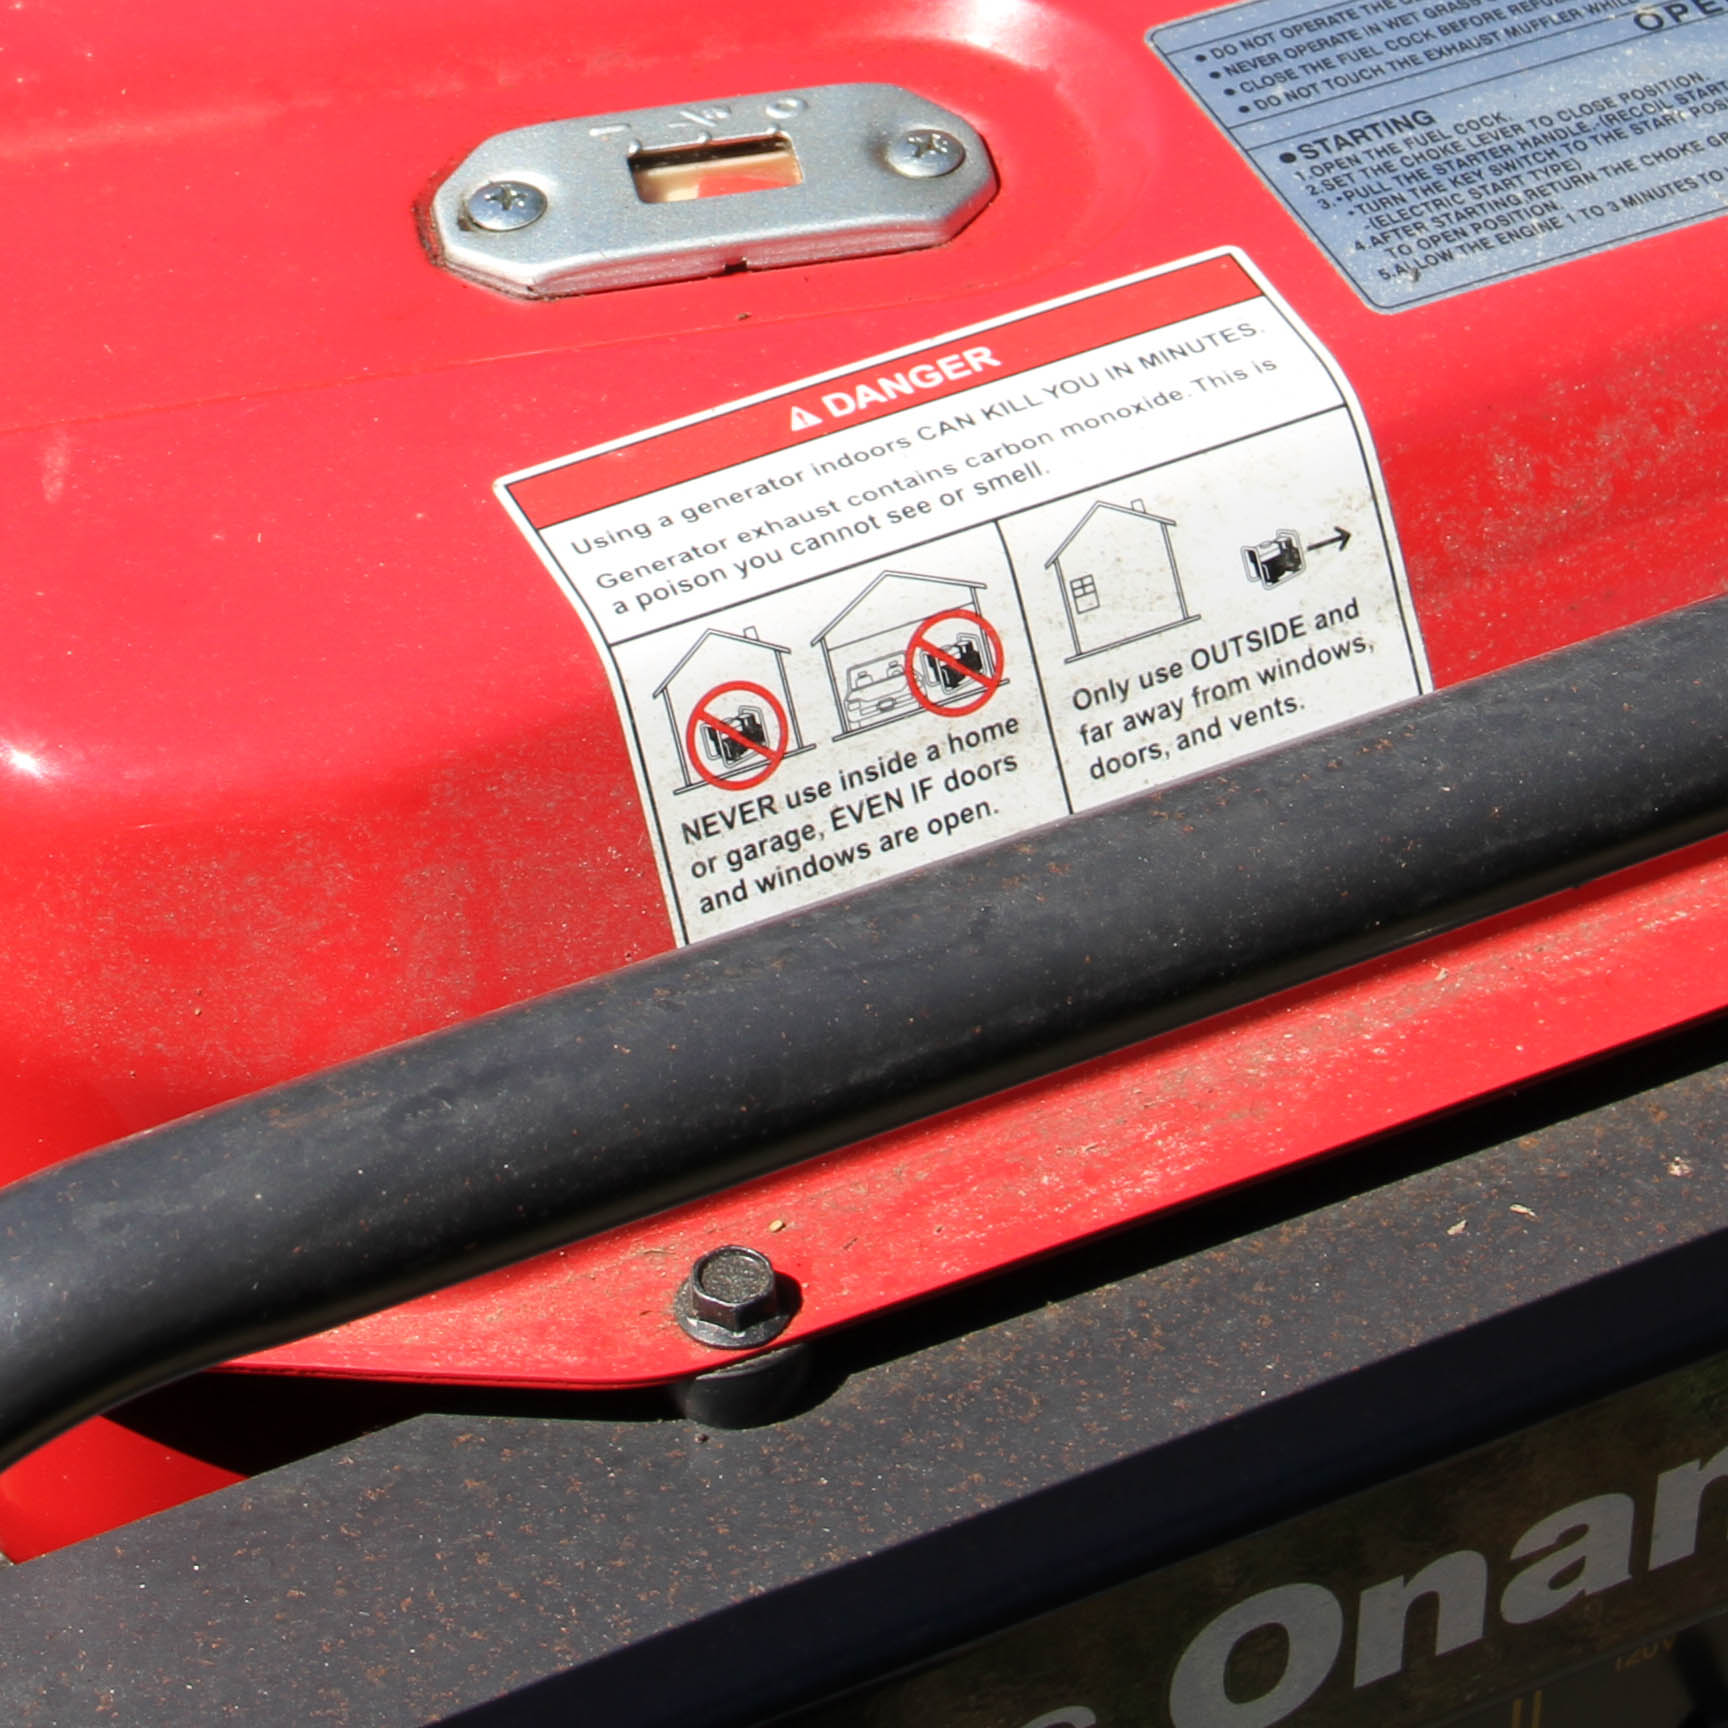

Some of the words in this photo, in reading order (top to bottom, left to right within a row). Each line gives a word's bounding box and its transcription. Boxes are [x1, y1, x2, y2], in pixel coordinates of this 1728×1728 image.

[1208, 42, 1239, 61] DO
[1238, 31, 1277, 52] NOT
[1278, 7, 1361, 40] OPERATE
[1238, 67, 1301, 94] CLOSE
[1297, 56, 1338, 76] THE
[1335, 45, 1385, 66] FUEL
[1383, 28, 1438, 52] COCK
[1435, 7, 1508, 38] BEFORE
[1252, 94, 1283, 112] DO
[1282, 81, 1321, 103] NOT
[1320, 64, 1387, 91] TOUCH
[1384, 53, 1425, 73] THE
[1422, 29, 1502, 63] EXHAUST
[1502, 7, 1585, 39] MUFFLER
[1296, 109, 1437, 161] STARTING
[1357, 159, 1399, 181] THE
[1399, 140, 1468, 169] CHOKE
[1465, 122, 1527, 150] LEVER
[1524, 114, 1555, 131] TO
[1555, 95, 1619, 123] CLOSE
[1360, 141, 1404, 161] THE
[1401, 128, 1454, 151] FUEL
[1596, 158, 1640, 179] THE
[1638, 139, 1706, 168] CHOKE
[1382, 242, 1414, 260] TO
[1415, 226, 1470, 251] OPEN
[1453, 236, 1497, 256] THE
[1493, 215, 1565, 246] ENGINE
[1564, 212, 1578, 225] 1
[1576, 204, 1606, 221] TO
[1605, 200, 1622, 213] 3
[1618, 176, 1700, 209] MINUTES
[1696, 169, 1725, 186] TO
[820, 345, 1002, 419] DANGER
[569, 522, 653, 556] Using
[657, 514, 675, 529] a
[679, 469, 805, 524] generator
[809, 436, 913, 477] indoors
[915, 412, 977, 442] CAN
[979, 393, 1044, 422] KILL
[1040, 371, 1101, 400] YOU
[1103, 361, 1135, 382] IN
[595, 537, 728, 590] Generator
[736, 499, 843, 544] exhaust
[846, 463, 959, 508] contains
[964, 431, 1055, 469] carbon
[1189, 368, 1249, 393] This
[1252, 359, 1278, 375] is
[611, 599, 631, 616] a
[634, 567, 729, 613] poison
[732, 548, 785, 581] you
[789, 513, 883, 557] cannot
[885, 499, 933, 525] see
[938, 487, 965, 508] or
[1071, 677, 1131, 712] Only
[1137, 661, 1184, 691] use
[1189, 613, 1308, 672] OUTSIDE
[1313, 595, 1361, 632] and
[1077, 720, 1115, 747] far
[1121, 696, 1185, 733] away
[1190, 674, 1252, 709] from
[1255, 635, 1375, 687] windows,
[680, 793, 780, 846] NEVER
[784, 780, 833, 811] use
[837, 749, 919, 793] inside
[925, 743, 943, 763] a
[942, 716, 1020, 756] home
[1088, 741, 1171, 781] doors,
[1175, 714, 1224, 752] and
[690, 854, 719, 880] or
[724, 822, 826, 873] garage,
[828, 786, 906, 833] EVEN
[909, 775, 934, 805] IF
[943, 754, 1019, 794] doors
[698, 876, 750, 916] and
[753, 841, 873, 895] windows
[878, 825, 920, 854] are
